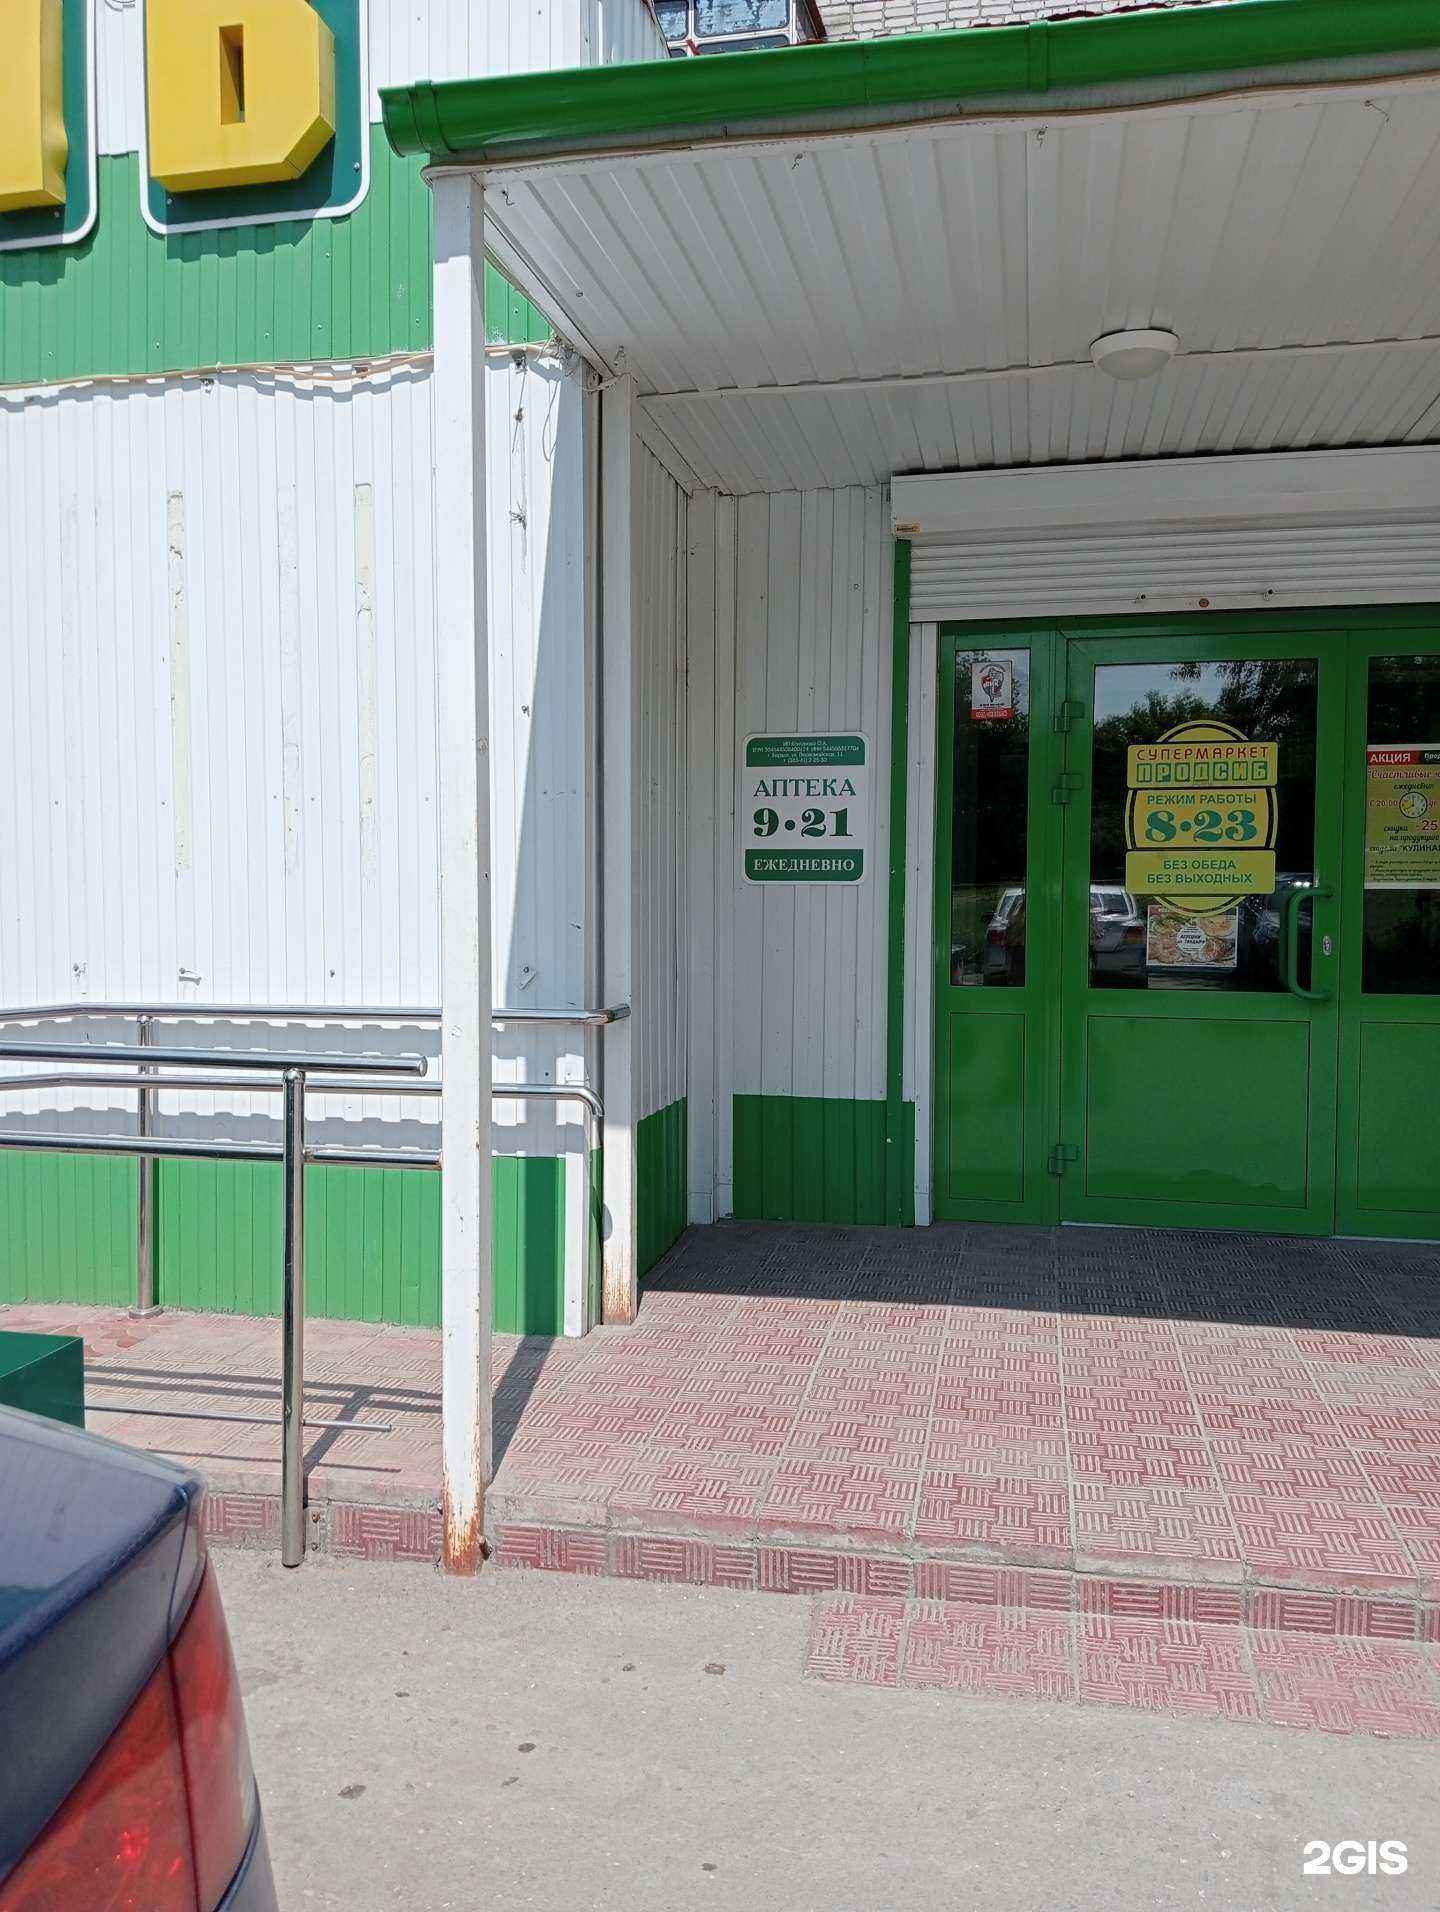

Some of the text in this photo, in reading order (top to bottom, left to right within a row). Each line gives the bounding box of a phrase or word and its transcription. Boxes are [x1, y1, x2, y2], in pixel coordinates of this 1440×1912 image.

[1136, 746, 1269, 760] СУПЕРМАРКЕТ
[1370, 752, 1411, 764] АКЦИЯ
[1136, 761, 1268, 783] ПРОДСИБ
[753, 778, 857, 797] АПТЕКА
[1147, 793, 1257, 805] РЕЖИМ РАБОТЫ
[753, 858, 855, 872] ЕЖЕДНЕВНО
[1163, 860, 1237, 871] БЕЗ ОБЕДА
[1147, 873, 1253, 885] БЕЗ ВЫХОДНЫХ
